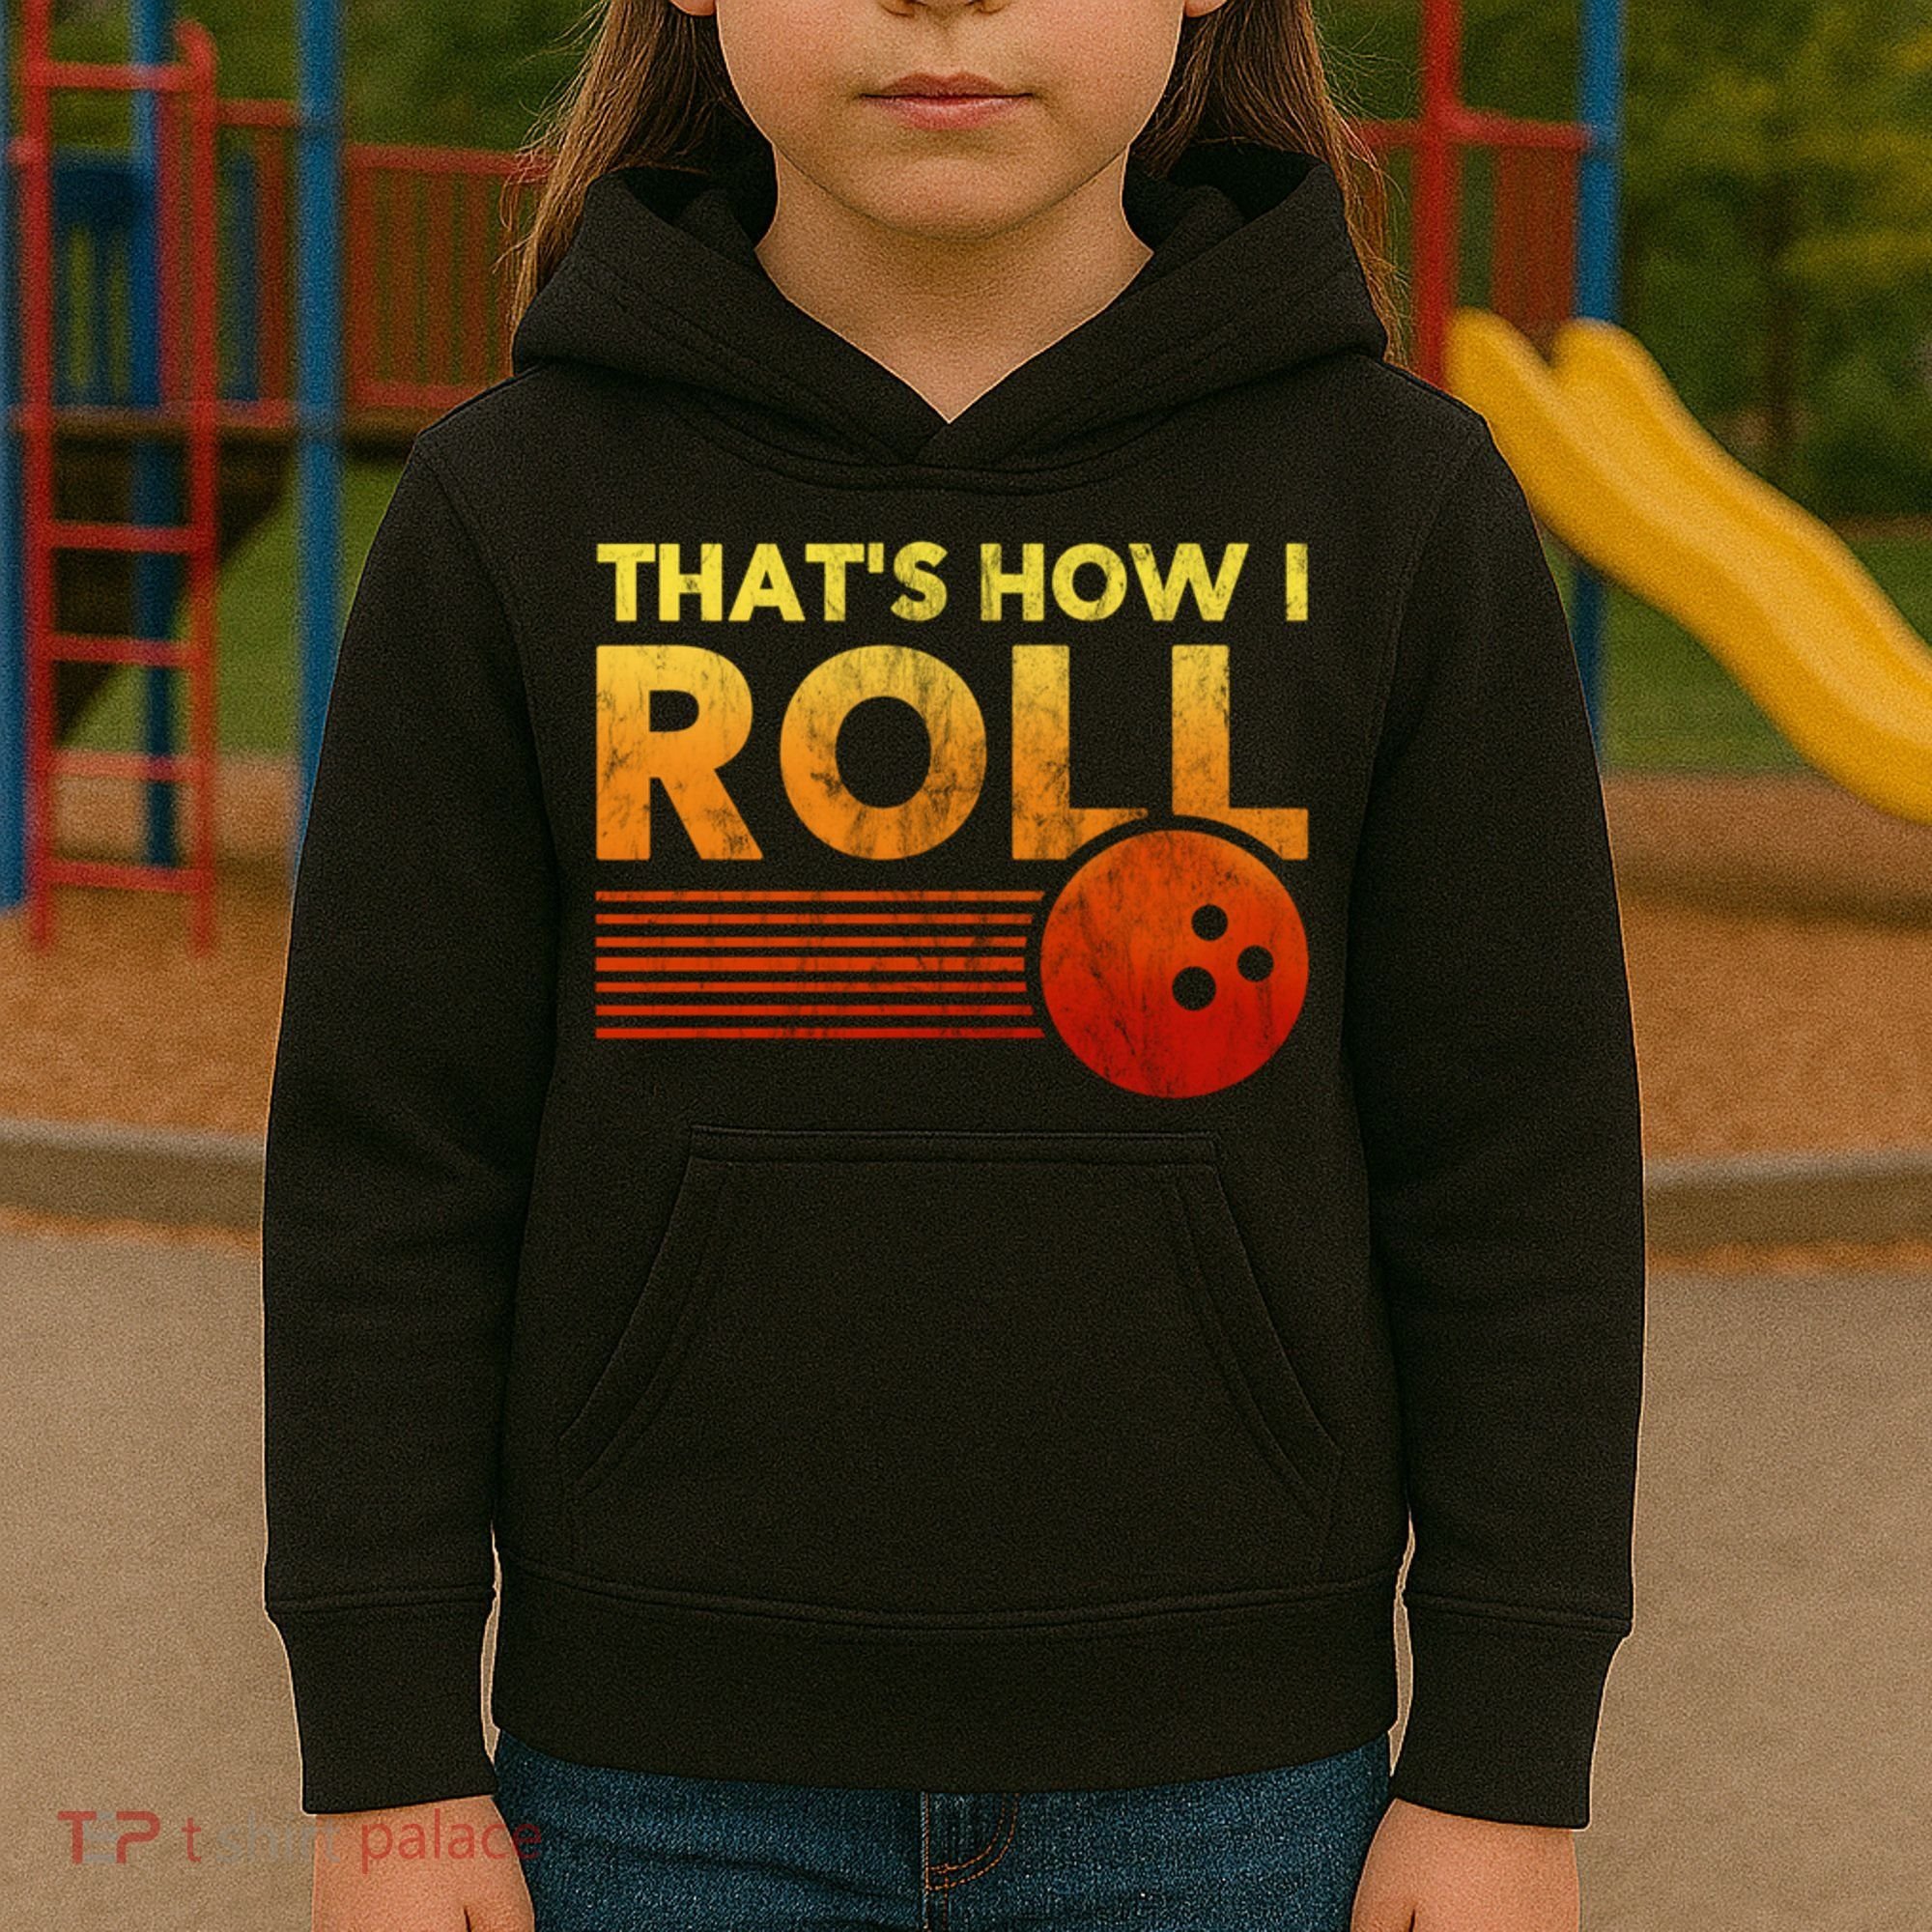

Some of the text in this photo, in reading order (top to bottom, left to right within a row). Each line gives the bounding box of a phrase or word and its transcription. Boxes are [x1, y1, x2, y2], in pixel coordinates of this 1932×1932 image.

[596, 541, 1309, 622] THAT'S HOW I
[595, 644, 1309, 861] ROLL
